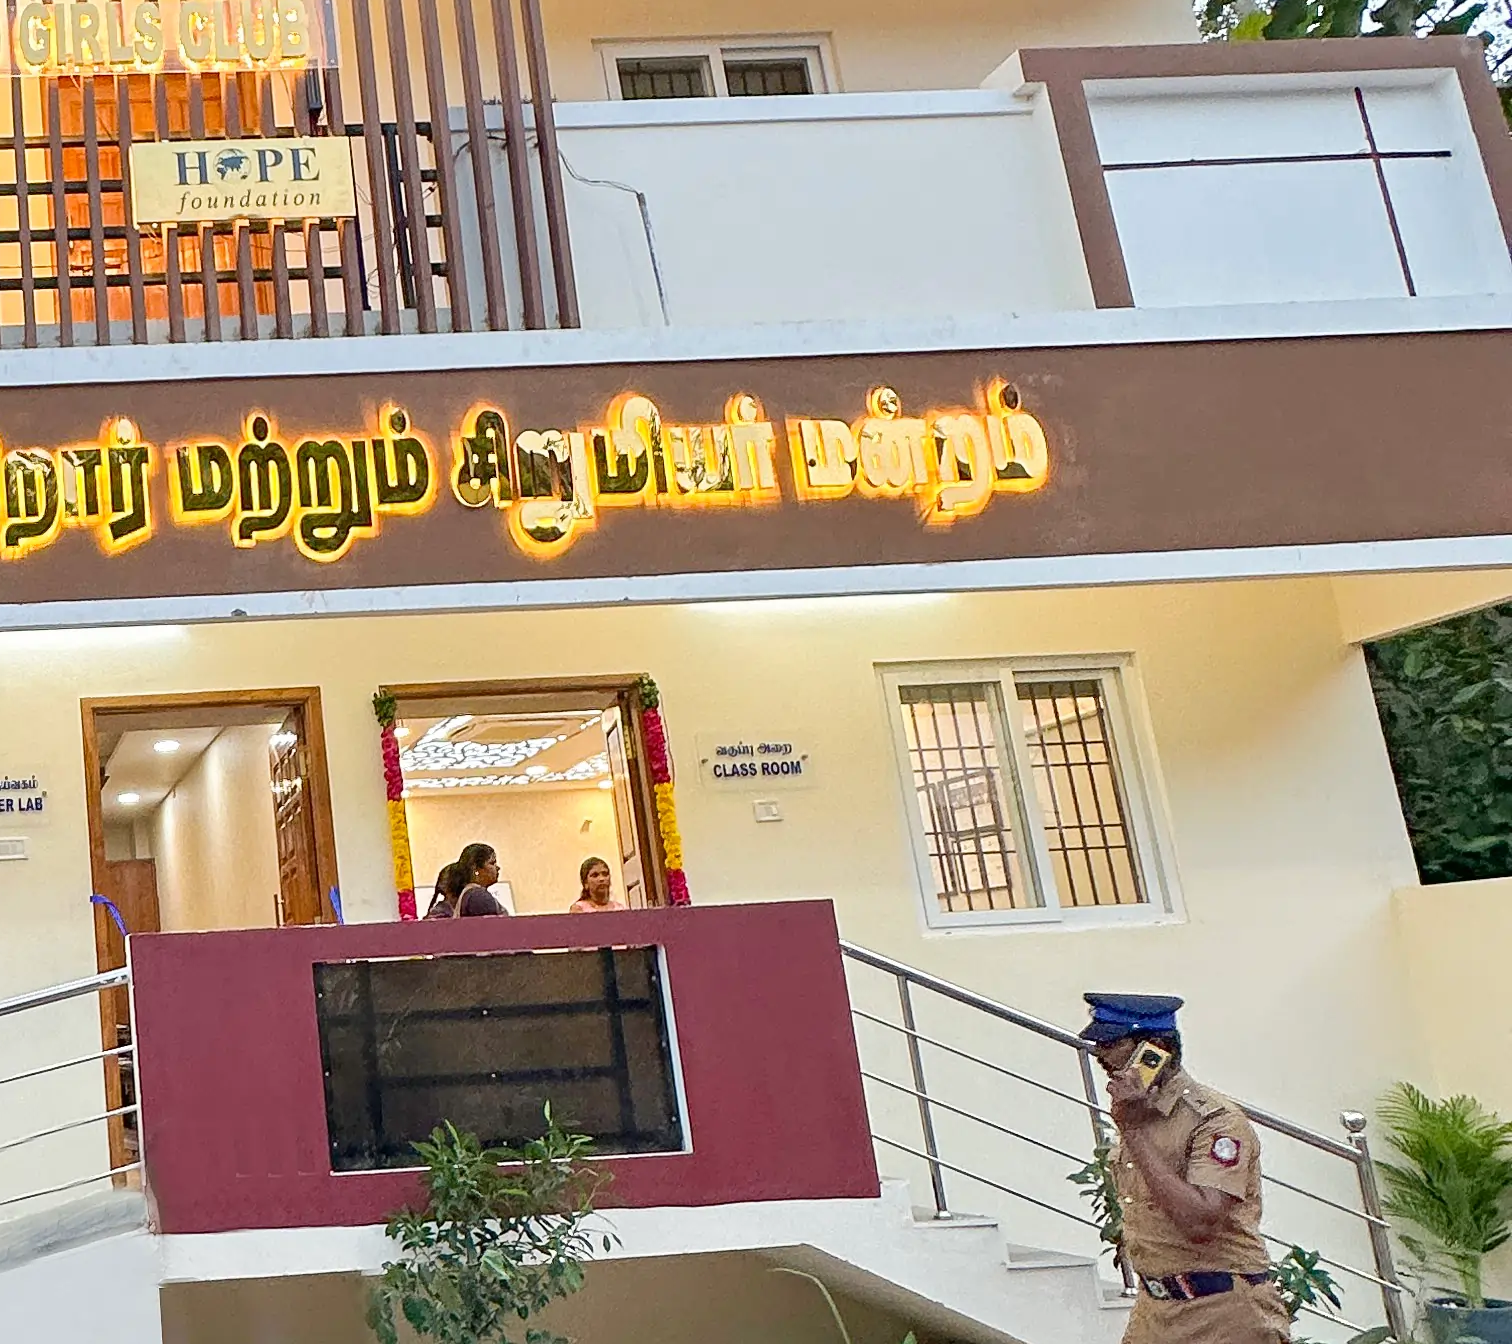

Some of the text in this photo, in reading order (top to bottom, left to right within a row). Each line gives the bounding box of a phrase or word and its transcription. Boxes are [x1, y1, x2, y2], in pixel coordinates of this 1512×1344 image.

[19, 2, 163, 65] GIRLS
[172, 147, 321, 187] HOPE
[175, 189, 322, 215] foundation
[177, 407, 429, 553] மற்றும்
[456, 393, 777, 544] சிறுமியர்
[799, 383, 1048, 513] மன்றம்
[713, 761, 802, 778] CLASS ROOM
[18, 797, 43, 812] LAB
